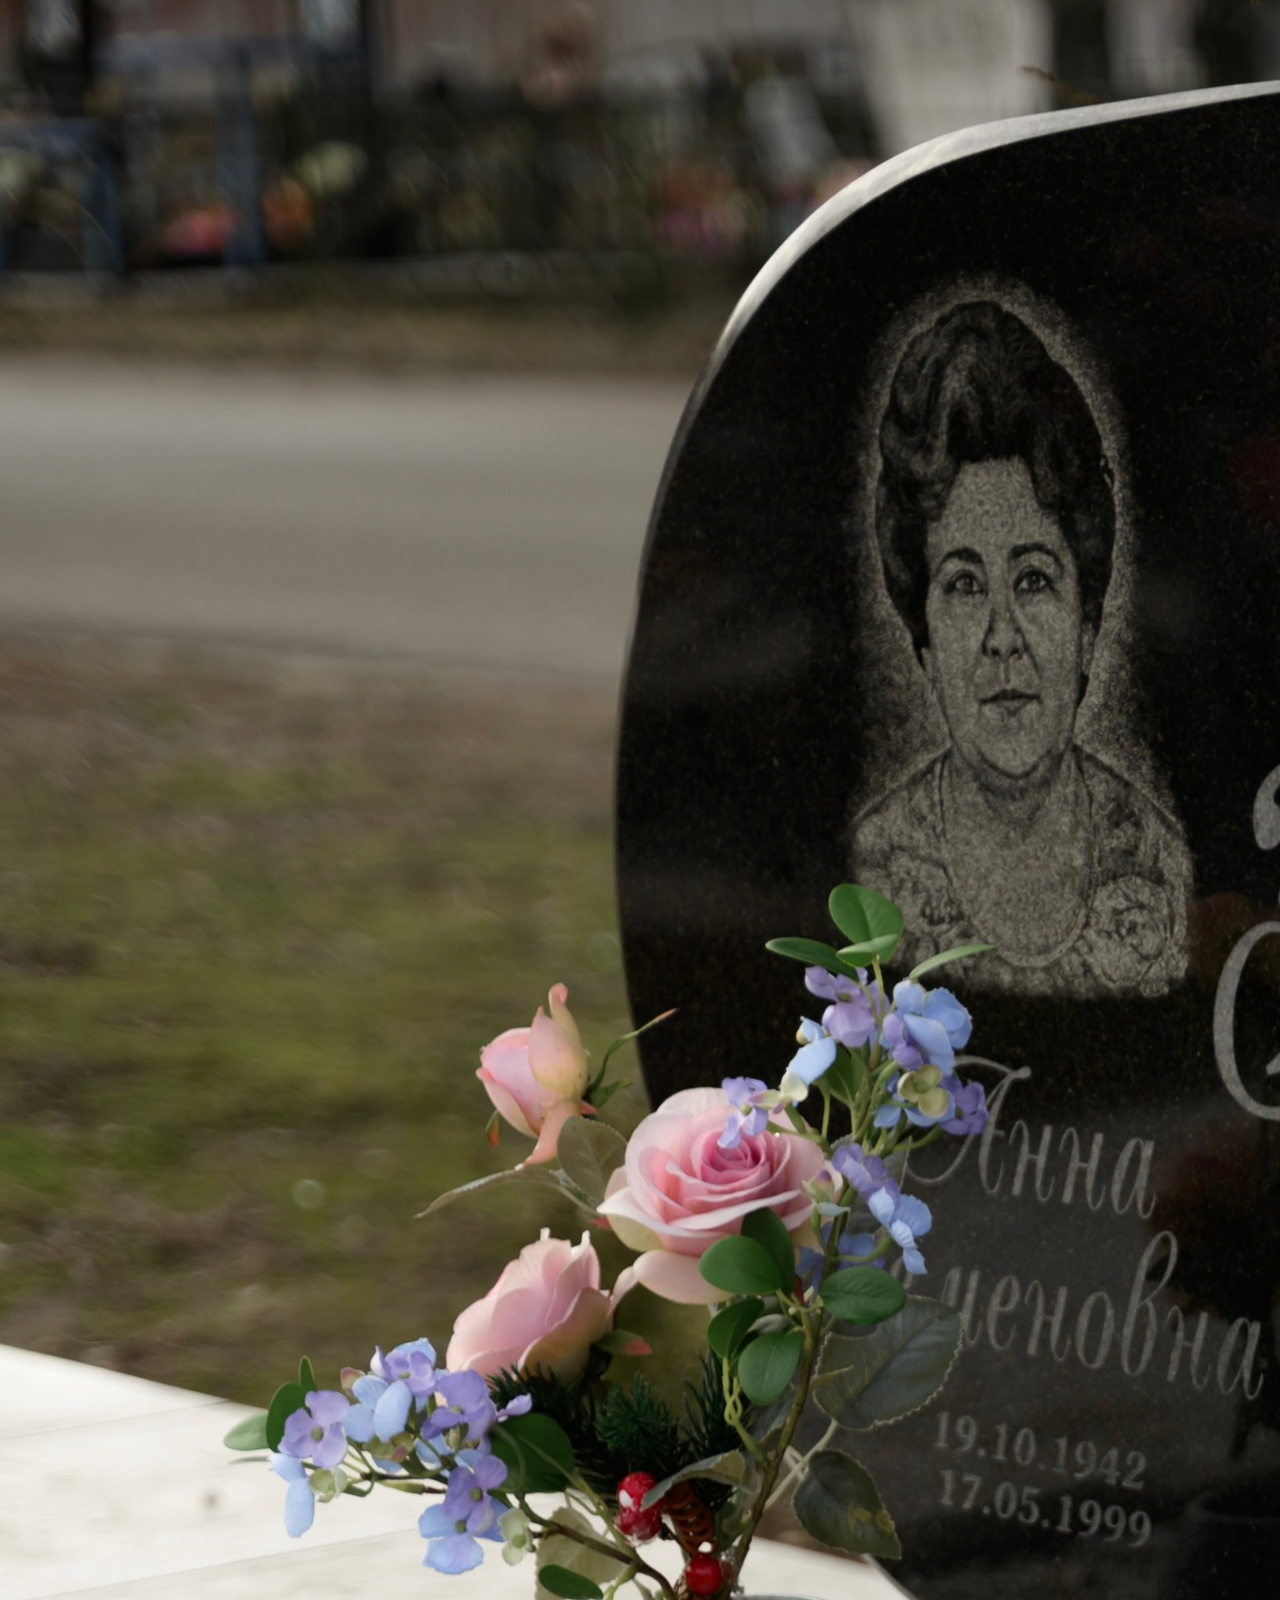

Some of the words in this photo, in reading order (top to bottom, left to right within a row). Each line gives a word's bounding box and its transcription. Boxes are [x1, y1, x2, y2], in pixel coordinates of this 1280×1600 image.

[905, 1054, 1159, 1220] Анна
[890, 1230, 1264, 1400] меновна
[934, 1410, 1148, 1491] 19.10.1942
[938, 1469, 1153, 1548] 17.05.1999
